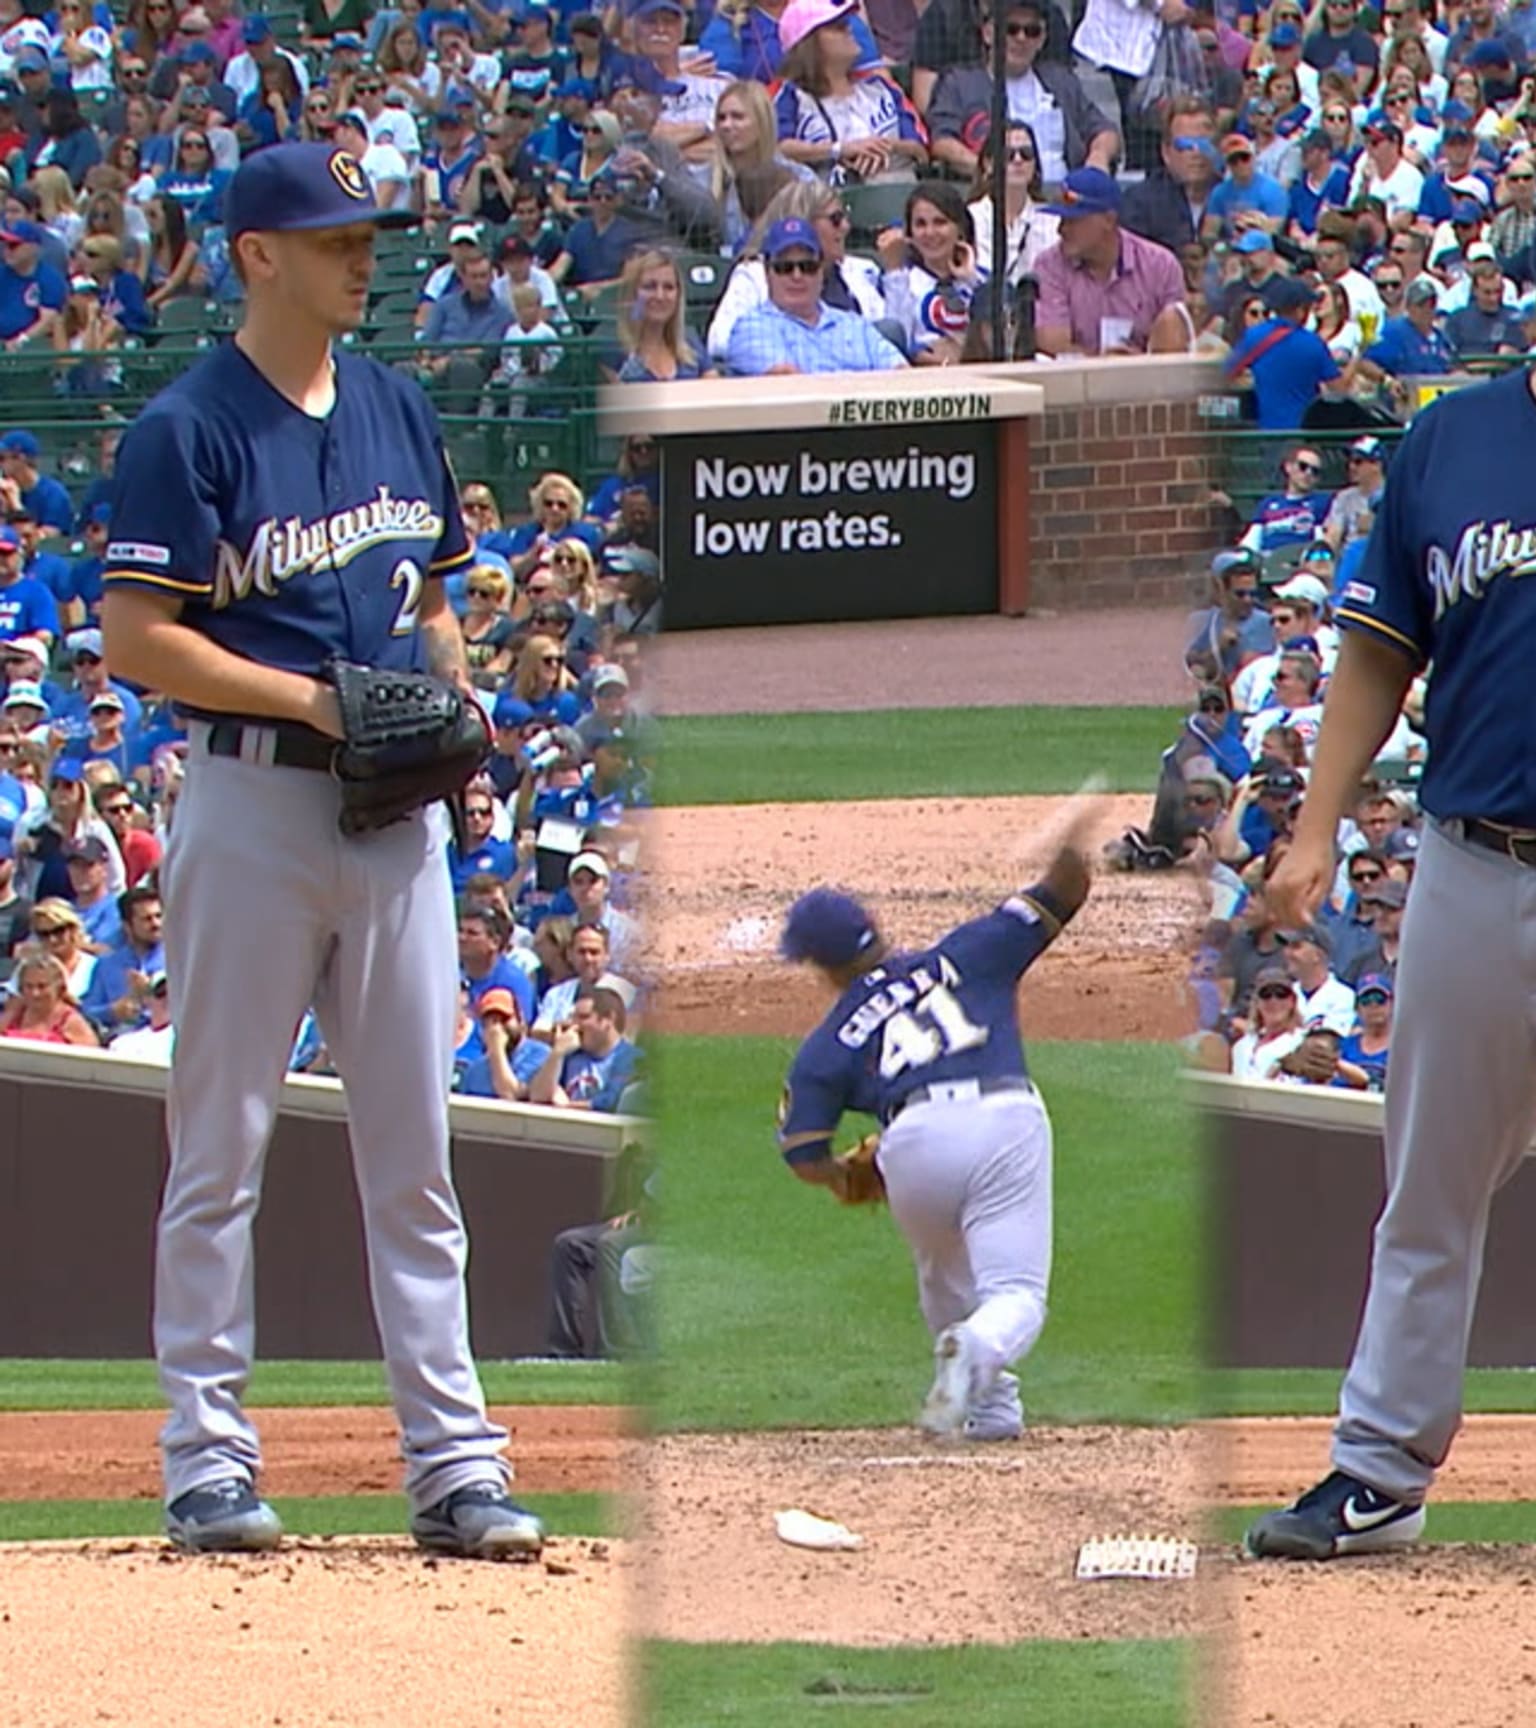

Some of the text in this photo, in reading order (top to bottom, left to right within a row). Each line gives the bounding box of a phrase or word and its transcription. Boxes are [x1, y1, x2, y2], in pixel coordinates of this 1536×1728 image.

[829, 394, 991, 424] #EVERYBODYIN
[695, 447, 975, 499] Now brewing
[213, 486, 444, 610] Milwaukee
[694, 509, 901, 556] low rates.
[389, 558, 424, 637] 2
[880, 984, 989, 1078] 41
